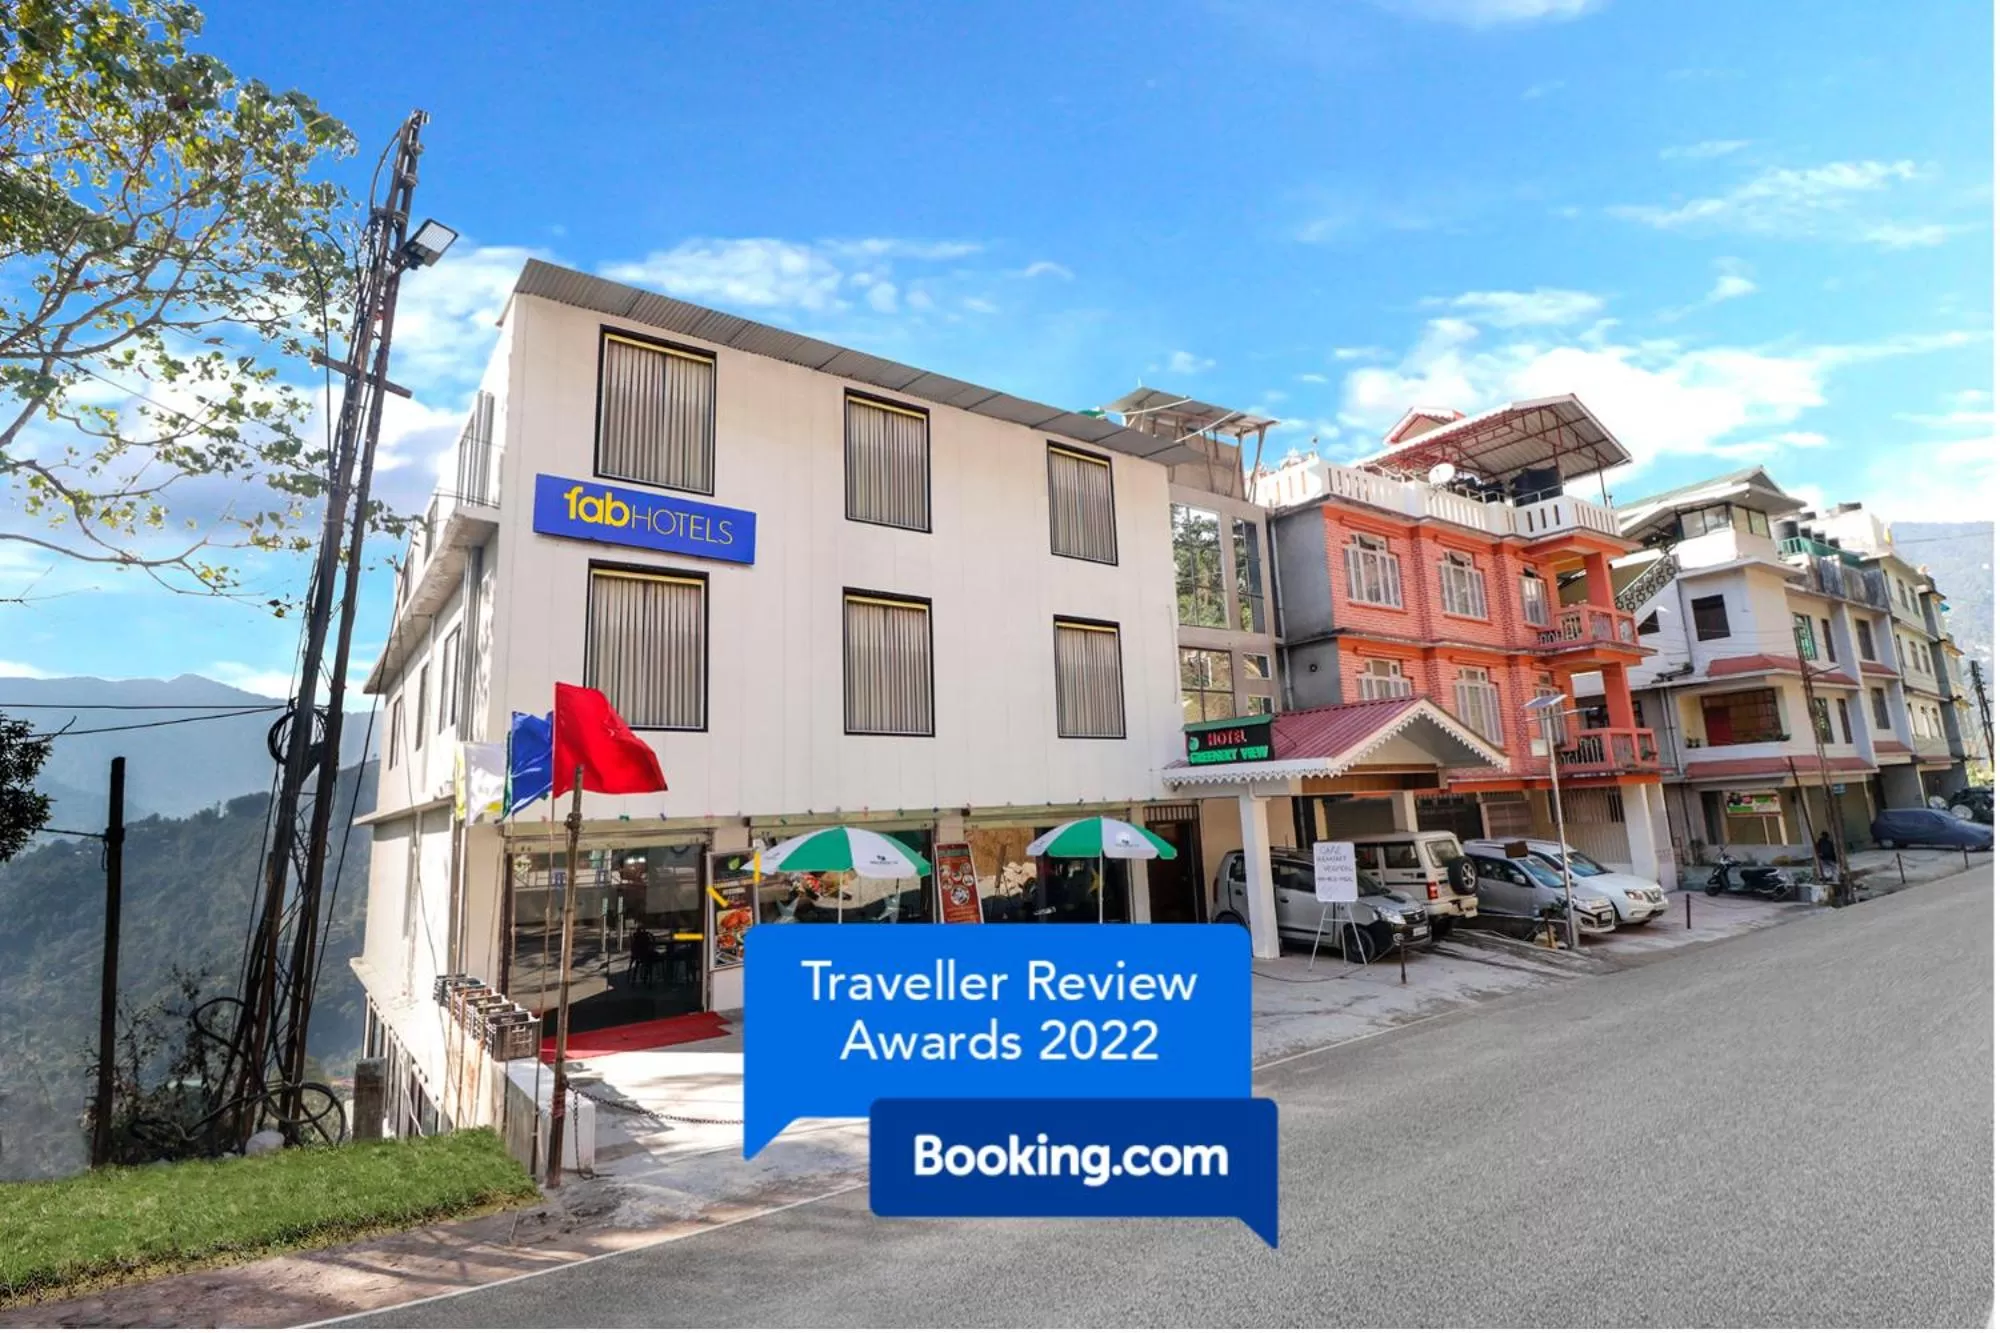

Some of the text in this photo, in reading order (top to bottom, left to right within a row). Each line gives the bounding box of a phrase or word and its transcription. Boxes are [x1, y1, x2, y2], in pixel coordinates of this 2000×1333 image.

[562, 486, 734, 546] fabHOTELS
[1207, 729, 1247, 747] HOTEL
[1240, 745, 1269, 760] VIEW
